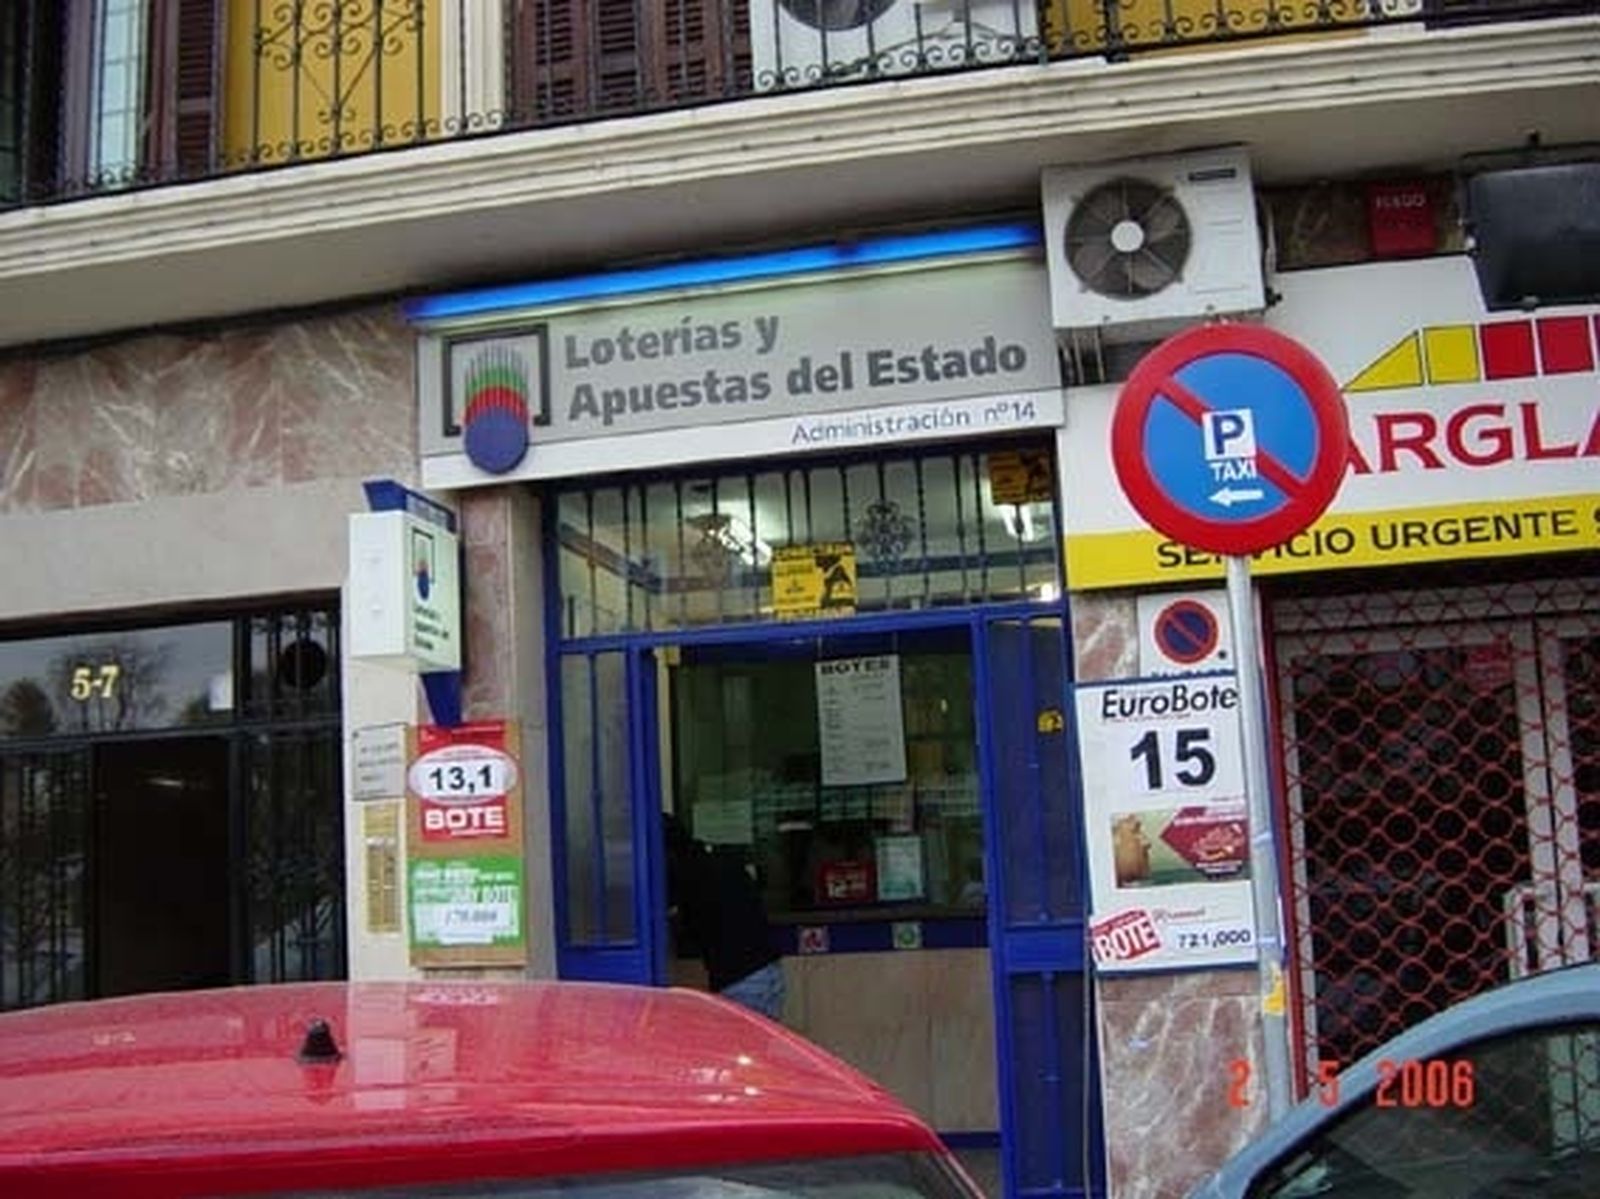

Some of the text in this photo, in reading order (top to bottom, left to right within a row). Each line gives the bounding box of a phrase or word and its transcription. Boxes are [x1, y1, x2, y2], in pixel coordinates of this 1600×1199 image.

[564, 314, 780, 369] Loterías y
[567, 335, 1028, 426] Apuestas del Estado
[792, 406, 970, 444] Administración
[1212, 414, 1245, 455] P
[1346, 402, 1600, 475] RGL
[1209, 459, 1258, 482] TAXI
[1371, 509, 1579, 550] URGENTE
[71, 664, 120, 699] 5-7
[1102, 684, 1239, 719] EuroBote
[429, 764, 492, 793] 13,1
[1130, 728, 1216, 791] 15
[425, 806, 504, 830] BOTE
[1094, 919, 1158, 963] BOTE
